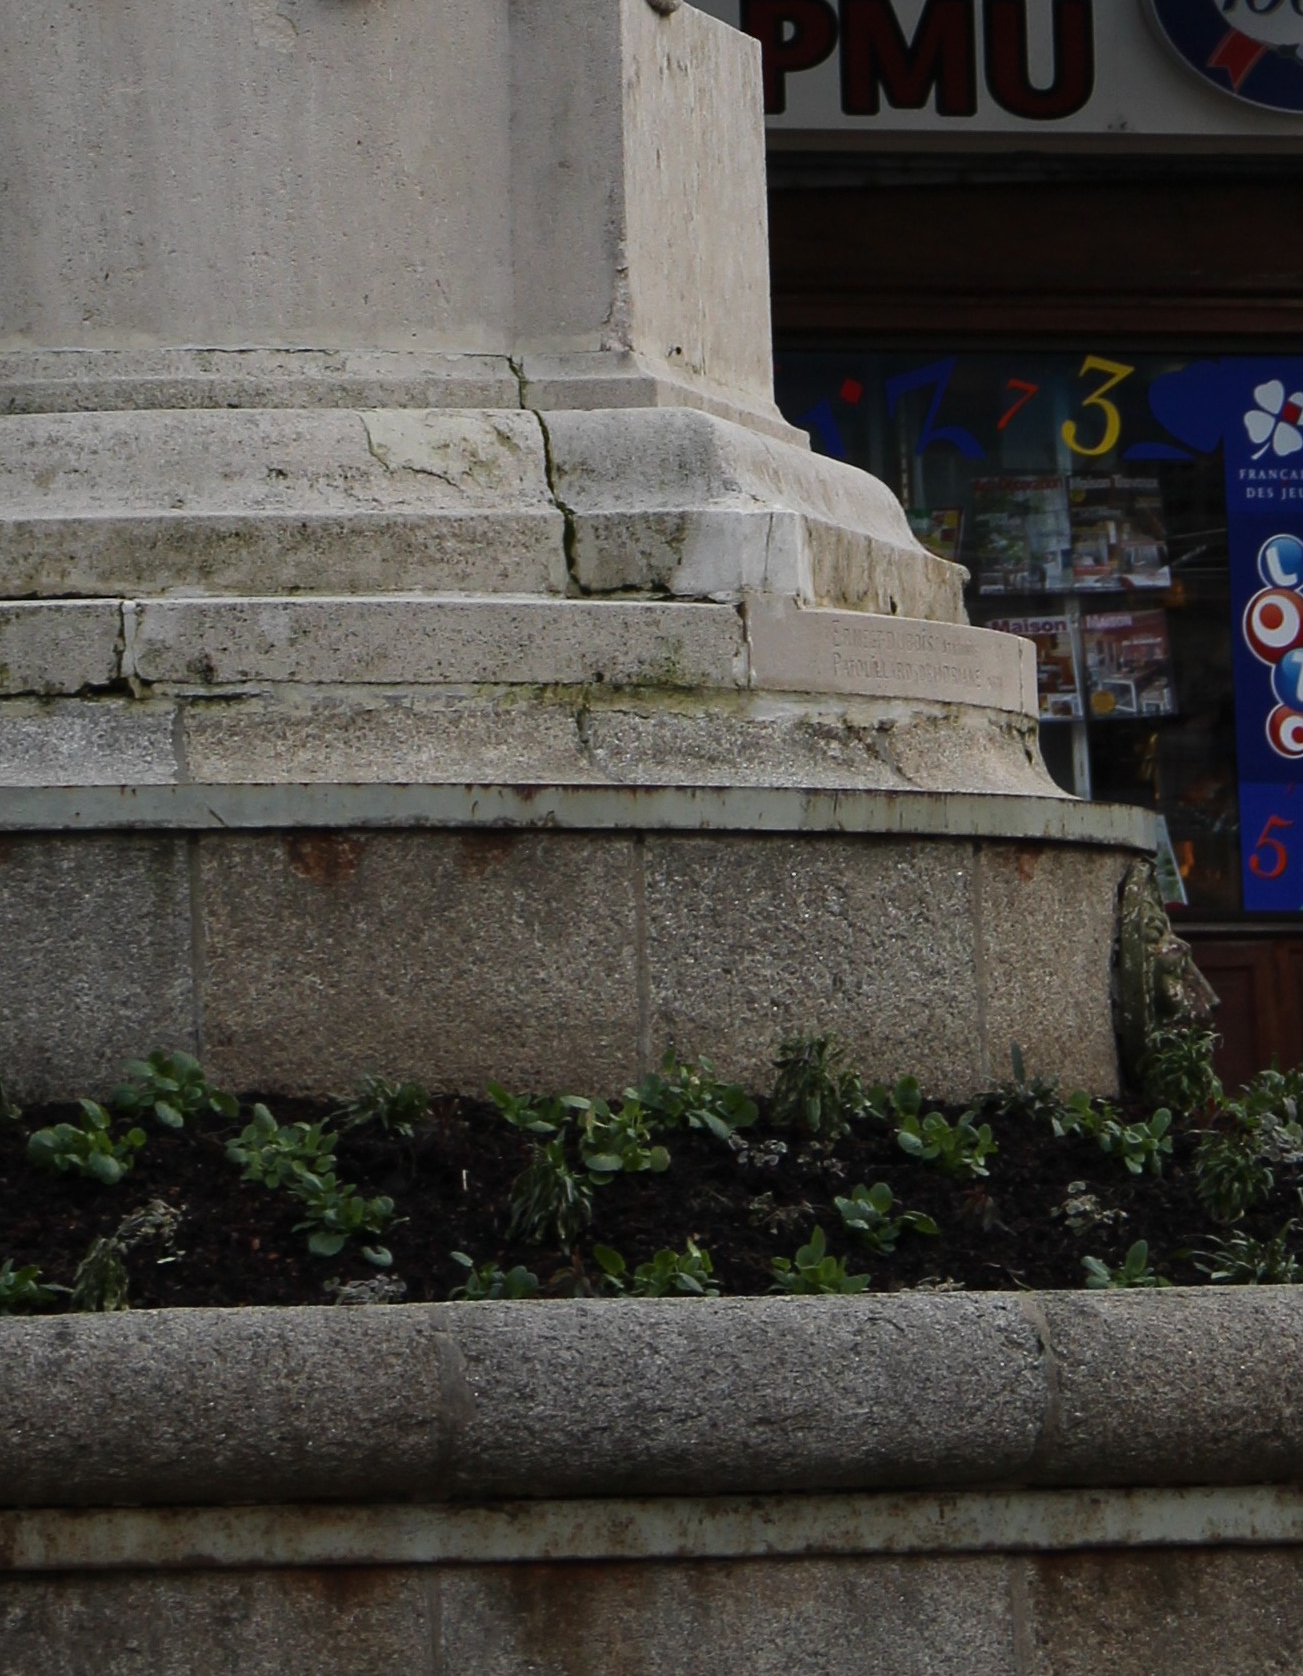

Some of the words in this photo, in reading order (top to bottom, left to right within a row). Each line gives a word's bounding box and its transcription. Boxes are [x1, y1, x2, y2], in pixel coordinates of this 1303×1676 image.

[1061, 353, 1136, 457] 3
[1246, 487, 1274, 499] DES
[1249, 814, 1294, 881] 5
